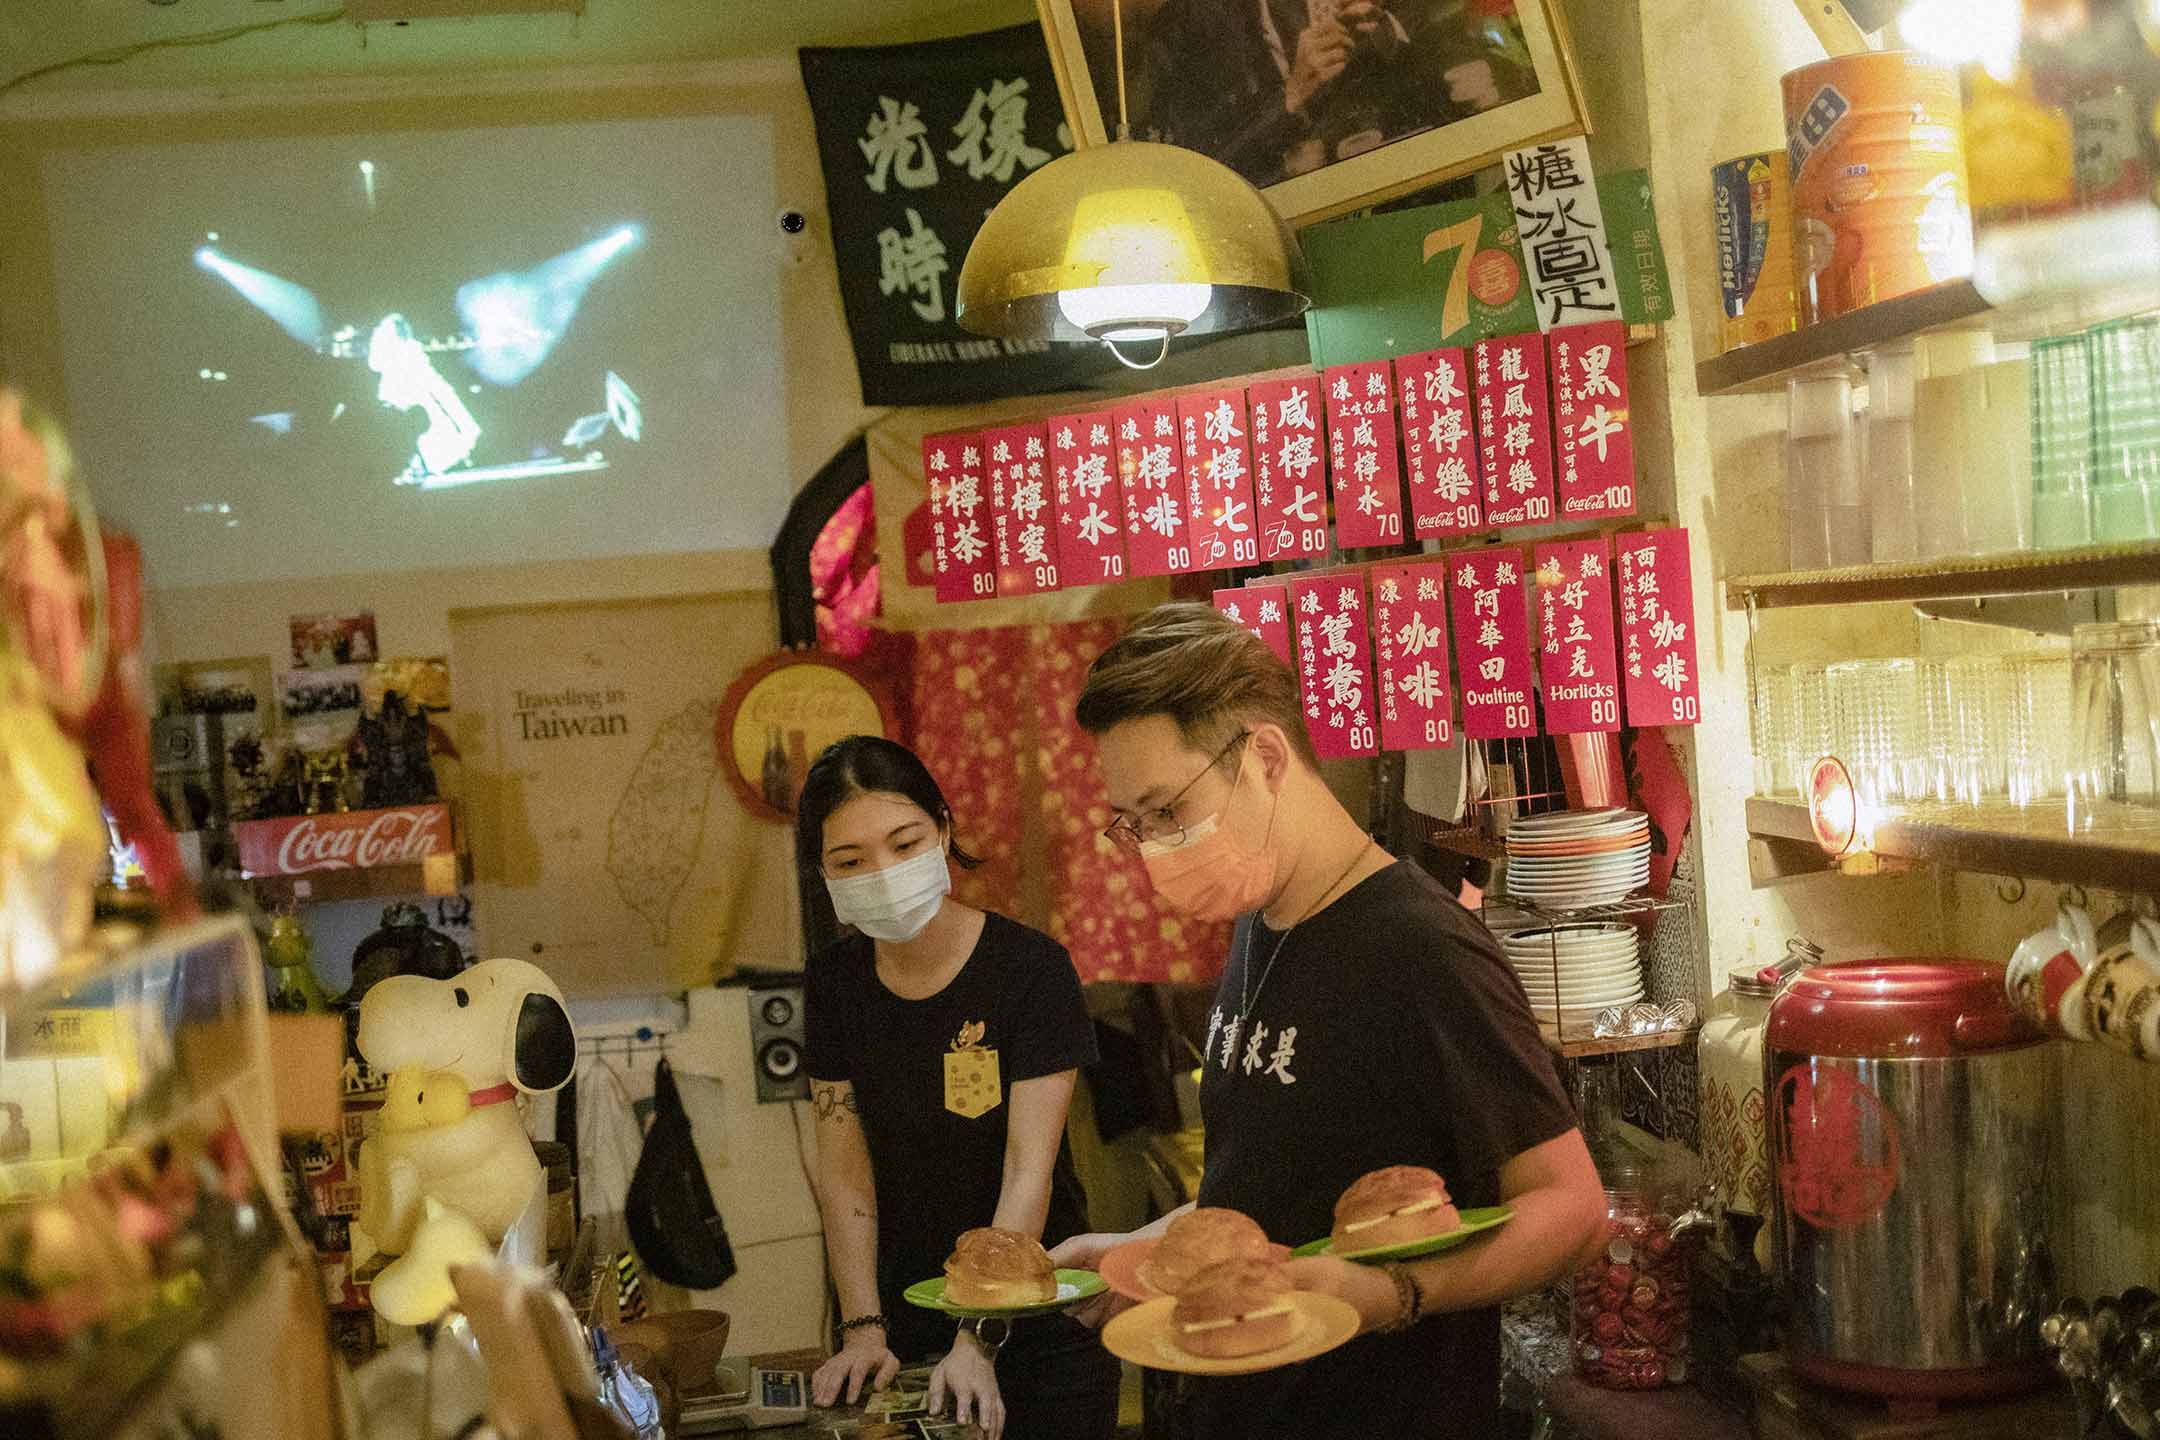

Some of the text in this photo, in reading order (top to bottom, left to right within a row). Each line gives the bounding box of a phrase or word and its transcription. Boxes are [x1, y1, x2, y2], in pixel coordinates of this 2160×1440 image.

[859, 77, 1072, 193] 光復
[1509, 145, 1616, 325] 糖冰固定
[877, 207, 948, 322] 時
[1577, 345, 1623, 462] 黑牛
[1497, 348, 1537, 494] 龍鳳檸樂
[1277, 386, 1318, 521] 咸檸七
[1408, 427, 1424, 484] 可口可樂
[1562, 424, 1578, 483] 可口可樂
[1204, 400, 1248, 532] 凍檸七
[1484, 445, 1500, 503] 可口可樂
[1337, 477, 1348, 490] 水
[1072, 453, 1117, 545] 檸水
[1524, 496, 1549, 519] 100
[1605, 486, 1631, 508] 100
[945, 474, 988, 564] 檸茶
[1061, 512, 1072, 524] 水
[1377, 513, 1399, 536] 70
[1457, 504, 1479, 528] 90
[1233, 538, 1255, 561] 80
[1303, 529, 1325, 551] 80
[1100, 555, 1122, 576] 70
[1168, 547, 1189, 569] 80
[973, 573, 993, 594] 80
[1036, 565, 1056, 587] 90
[1633, 546, 1660, 621] 西班牙
[1474, 588, 1505, 681] 阿華田
[1560, 581, 1594, 677] 好立克
[1319, 612, 1363, 711] 鴛鴦
[512, 688, 602, 709] Traveling
[1467, 687, 1524, 705] Ovaltine
[1551, 683, 1614, 700] Horlicks
[1506, 706, 1529, 728] 80
[1592, 700, 1616, 723] 80
[1672, 696, 1696, 720] 90
[512, 710, 628, 739] Taiwan
[1426, 720, 1448, 742] 80
[1350, 727, 1373, 749] 80
[278, 809, 444, 874] Coca-Cola
